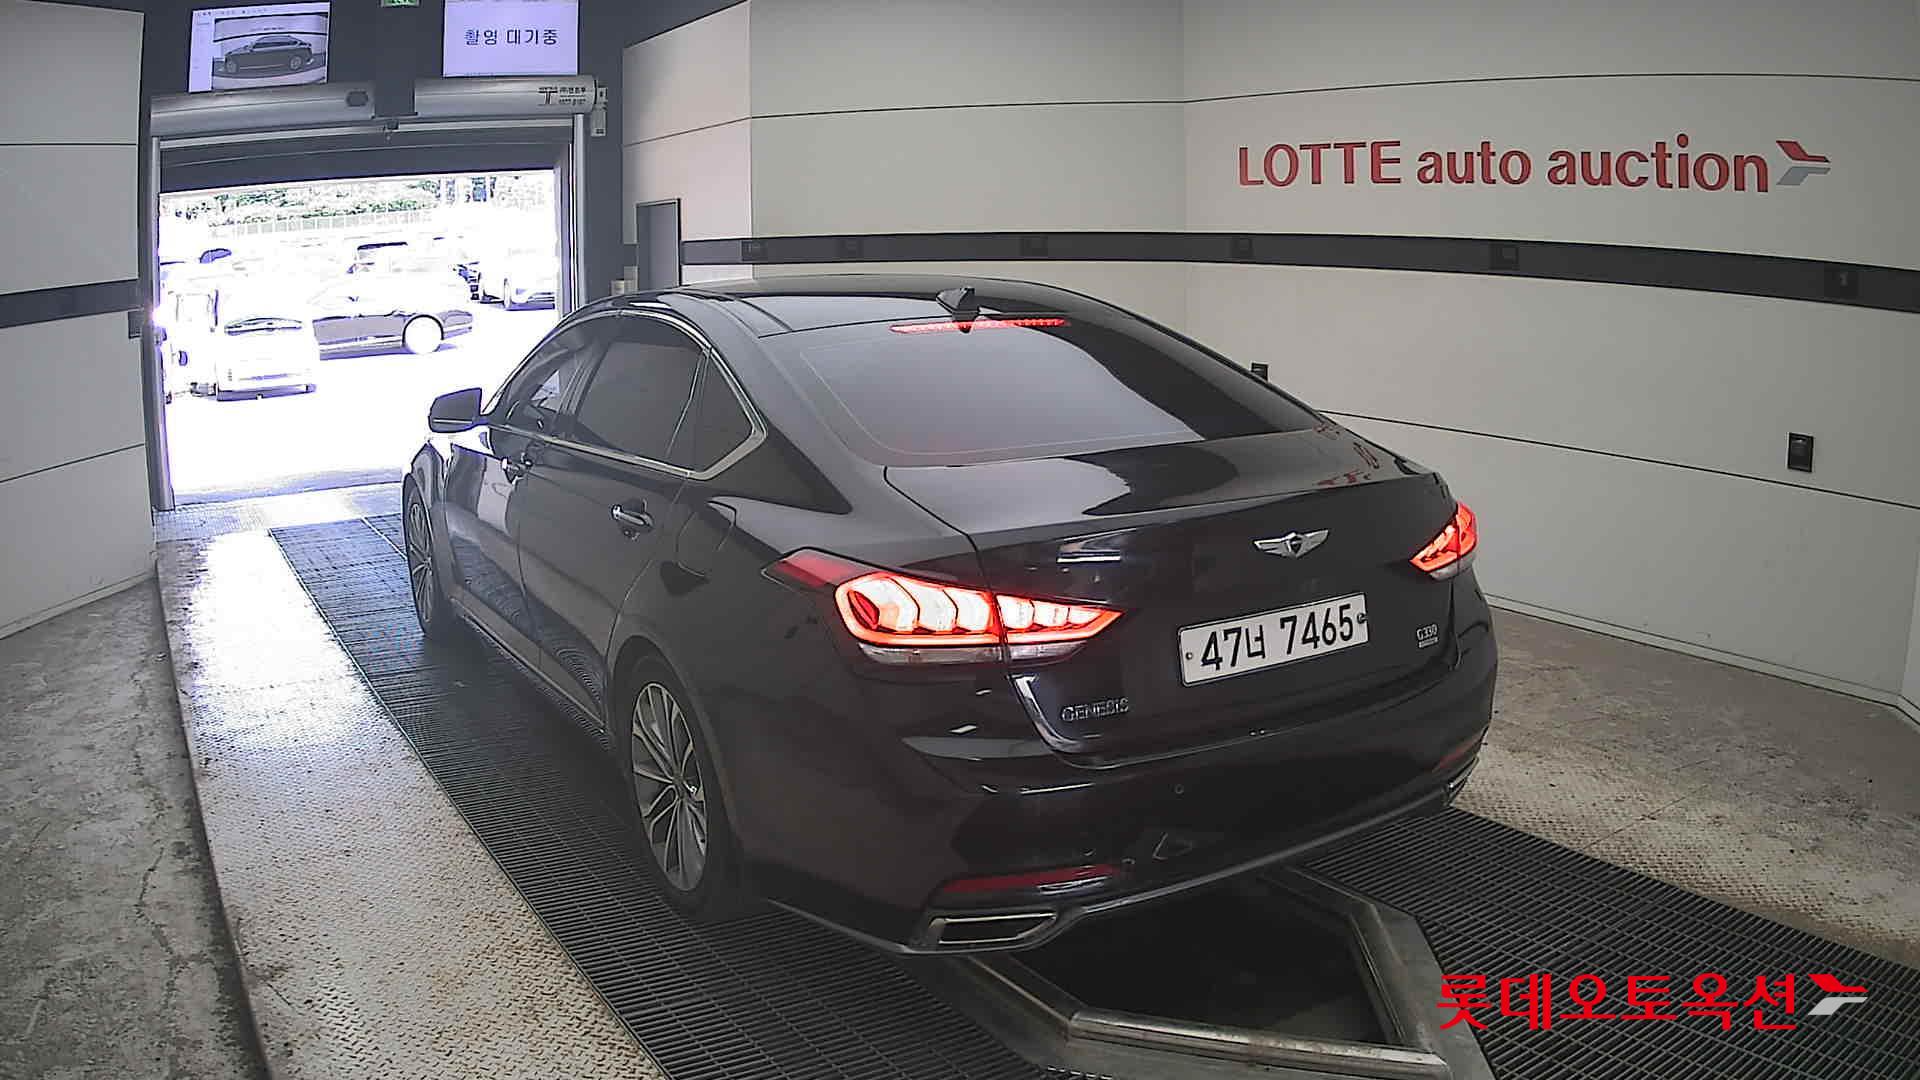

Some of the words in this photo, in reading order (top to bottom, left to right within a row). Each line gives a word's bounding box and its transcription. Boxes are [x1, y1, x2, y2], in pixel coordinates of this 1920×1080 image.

[506, 29, 558, 46] 대기중
[1239, 140, 1401, 187] LOTTE
[1417, 141, 1532, 185] auto
[1547, 133, 1769, 193] auction
[1201, 626, 1266, 671] 47너
[1280, 603, 1354, 655] 7465
[1061, 697, 1129, 722] GENESIS
